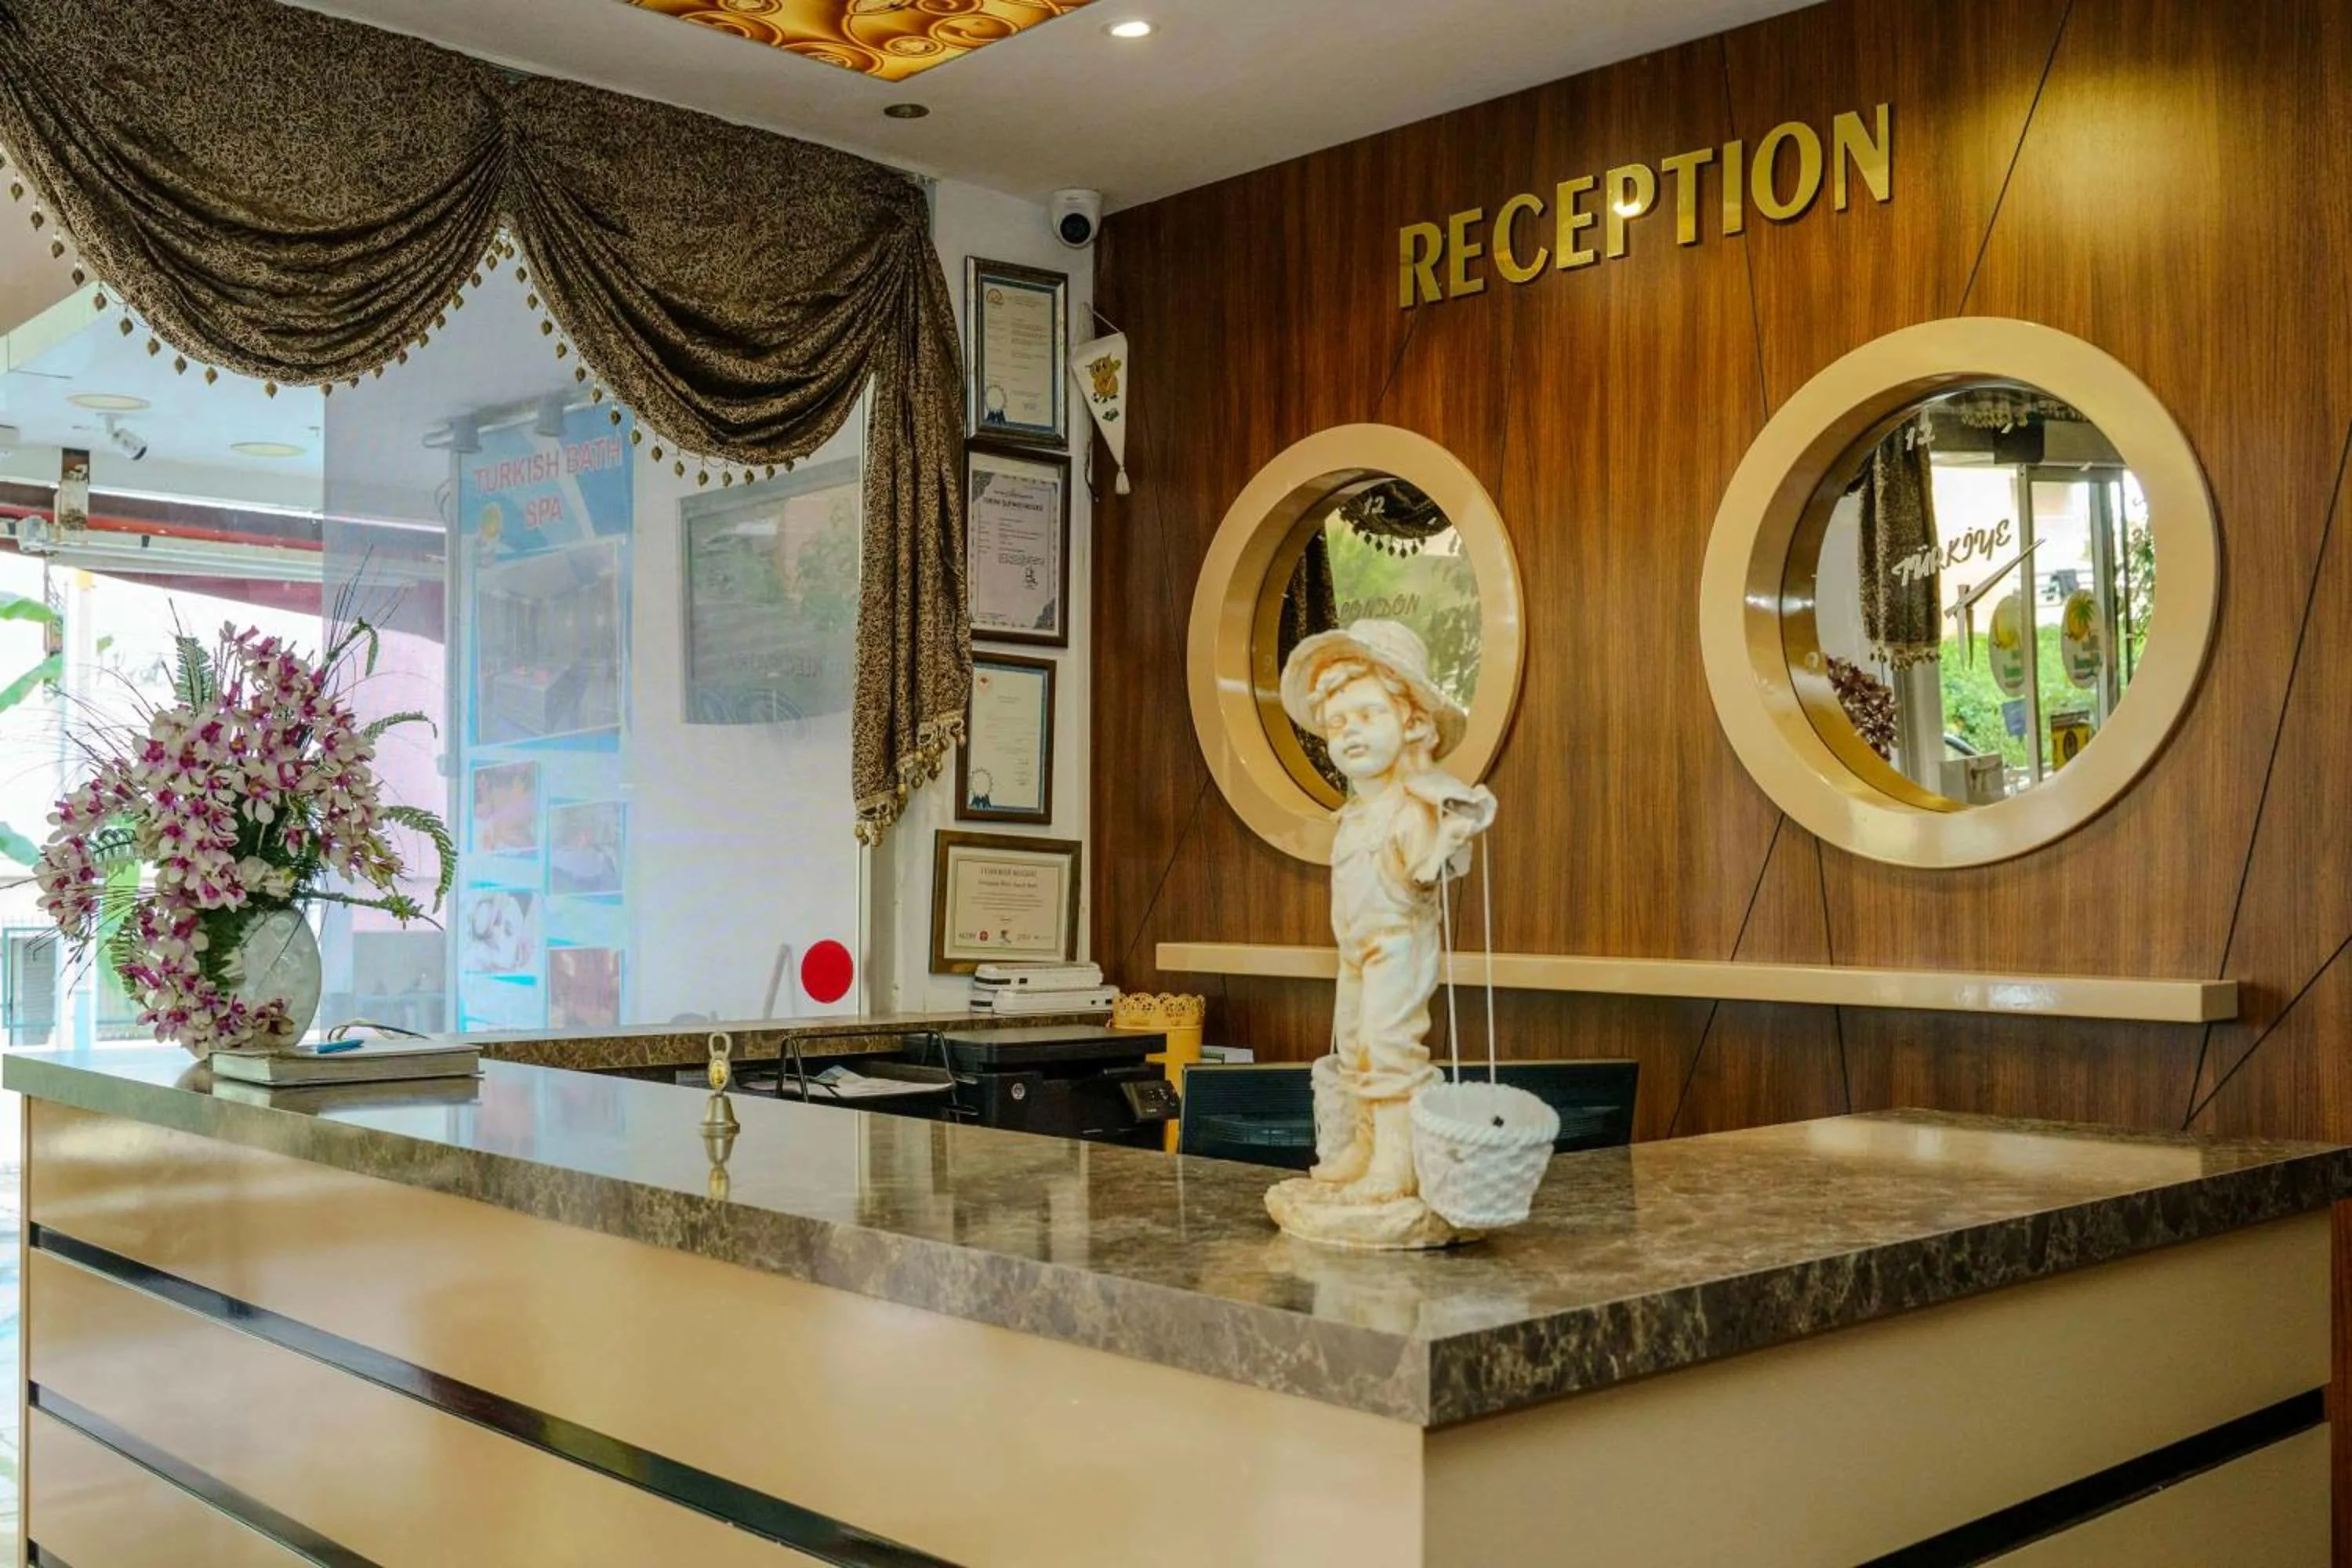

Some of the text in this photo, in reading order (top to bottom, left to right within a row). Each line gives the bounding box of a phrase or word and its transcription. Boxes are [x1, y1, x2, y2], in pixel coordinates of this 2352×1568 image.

[1399, 103, 1890, 308] RECEPTION
[1905, 423, 1935, 451] 12
[475, 436, 622, 492] TURKISH BATH
[526, 497, 563, 528] SPA
[1363, 496, 1385, 515] 12
